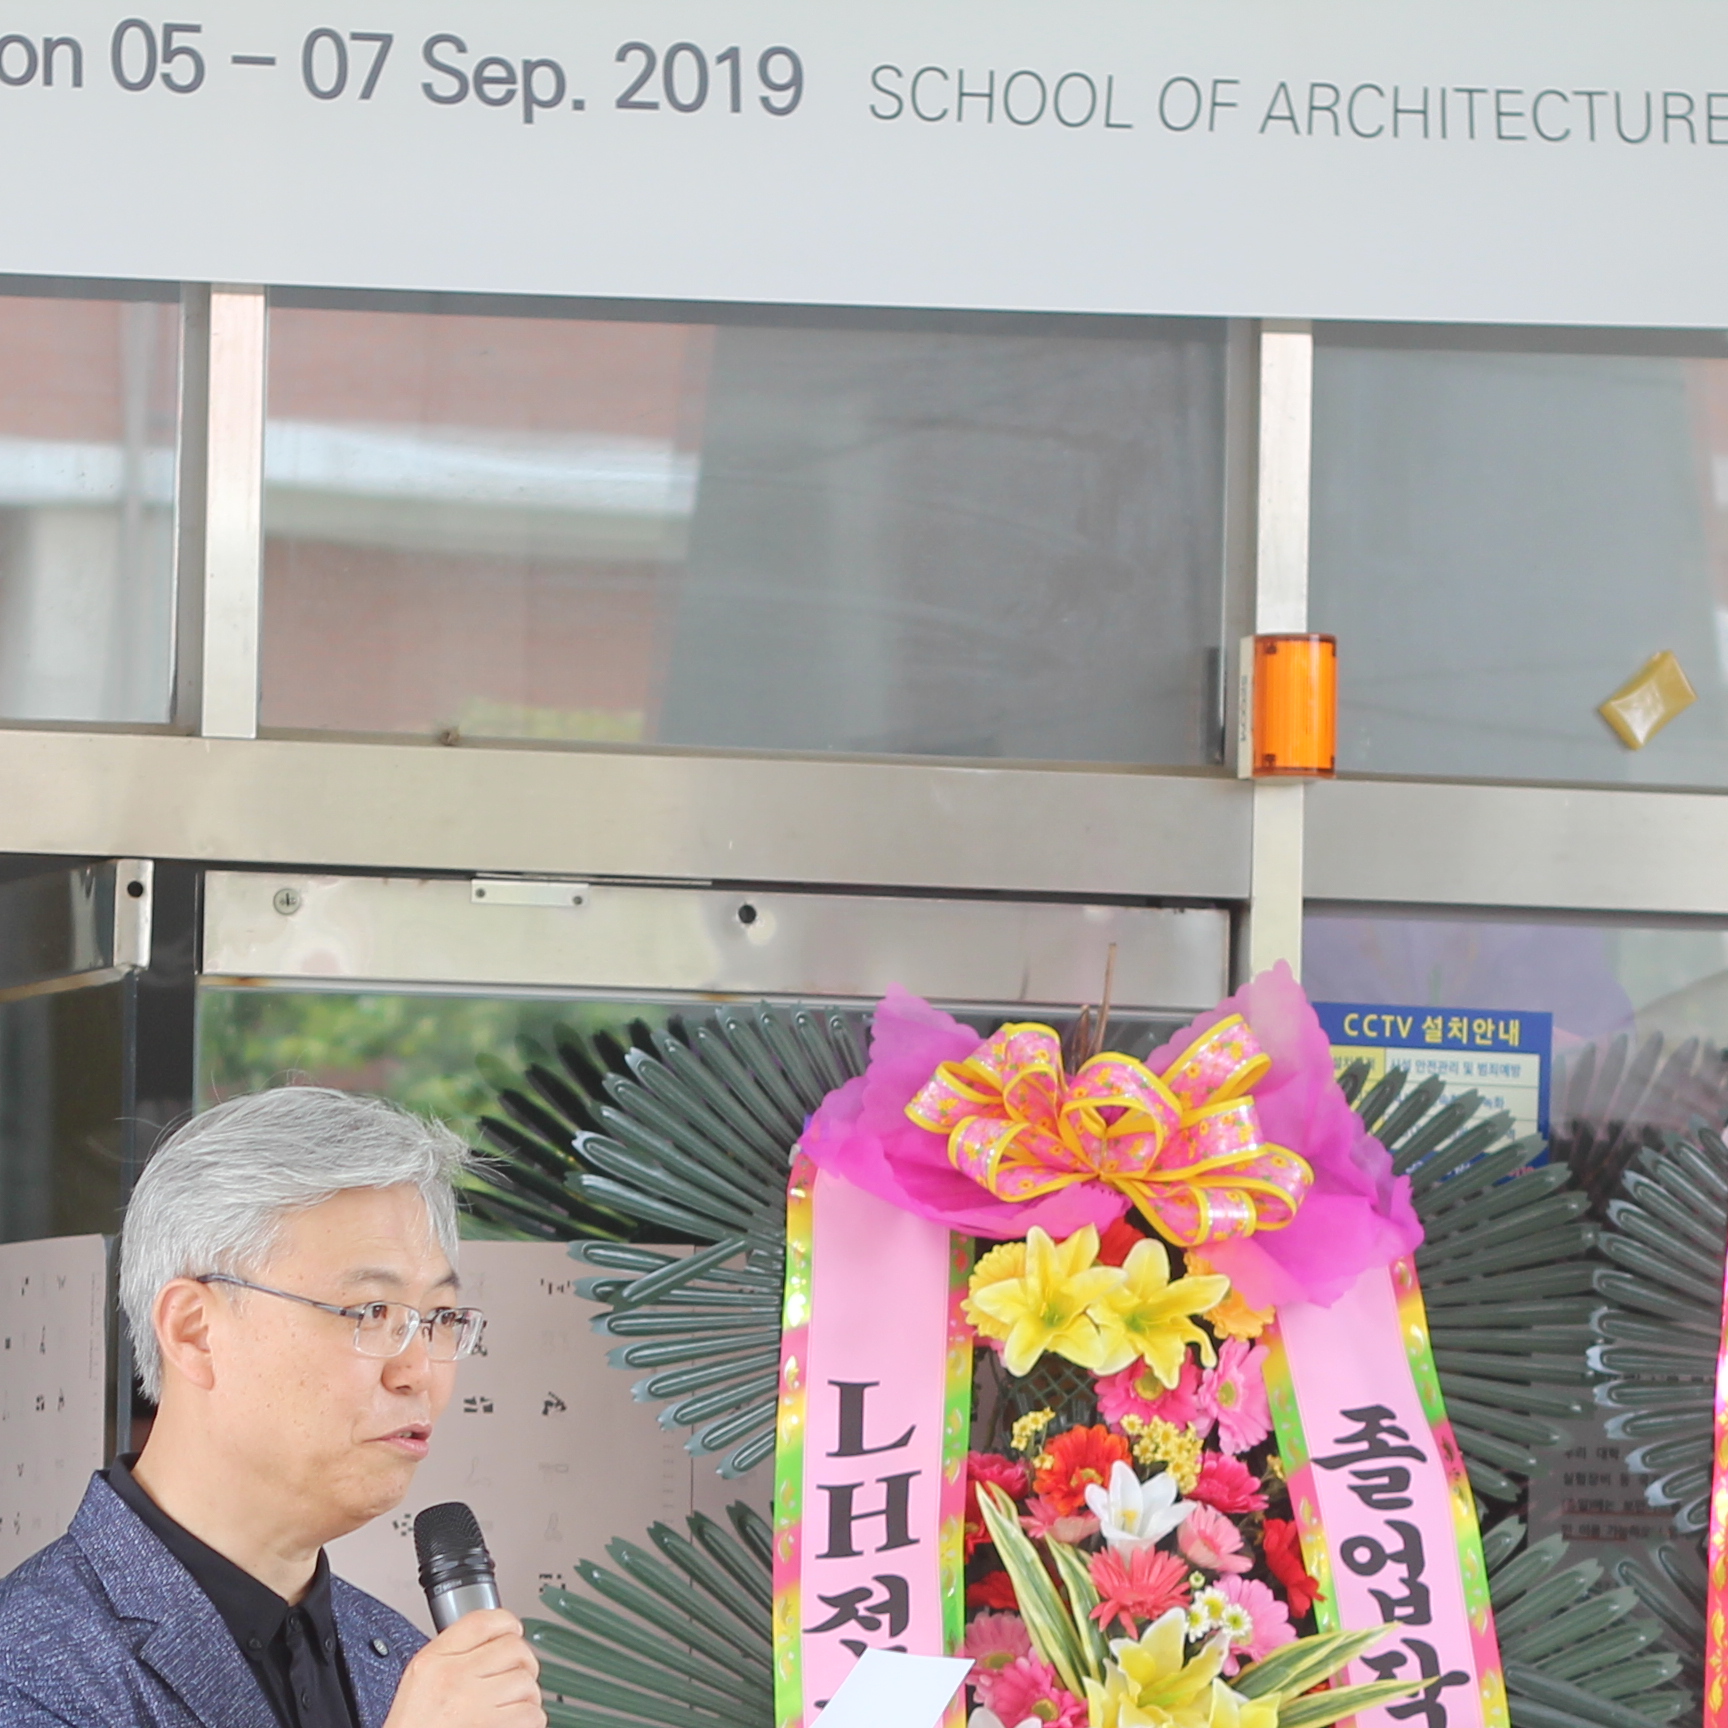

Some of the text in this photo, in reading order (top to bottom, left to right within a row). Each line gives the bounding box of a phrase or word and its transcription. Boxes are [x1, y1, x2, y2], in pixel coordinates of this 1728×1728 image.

[110, 16, 206, 96] 05
[301, 26, 396, 102] 07
[420, 31, 587, 126] Sep.
[613, 39, 806, 118] 2019
[868, 64, 1135, 131] SCHOOL
[1158, 74, 1242, 134] OF
[1342, 1012, 1522, 1048] CCTV 설치안내
